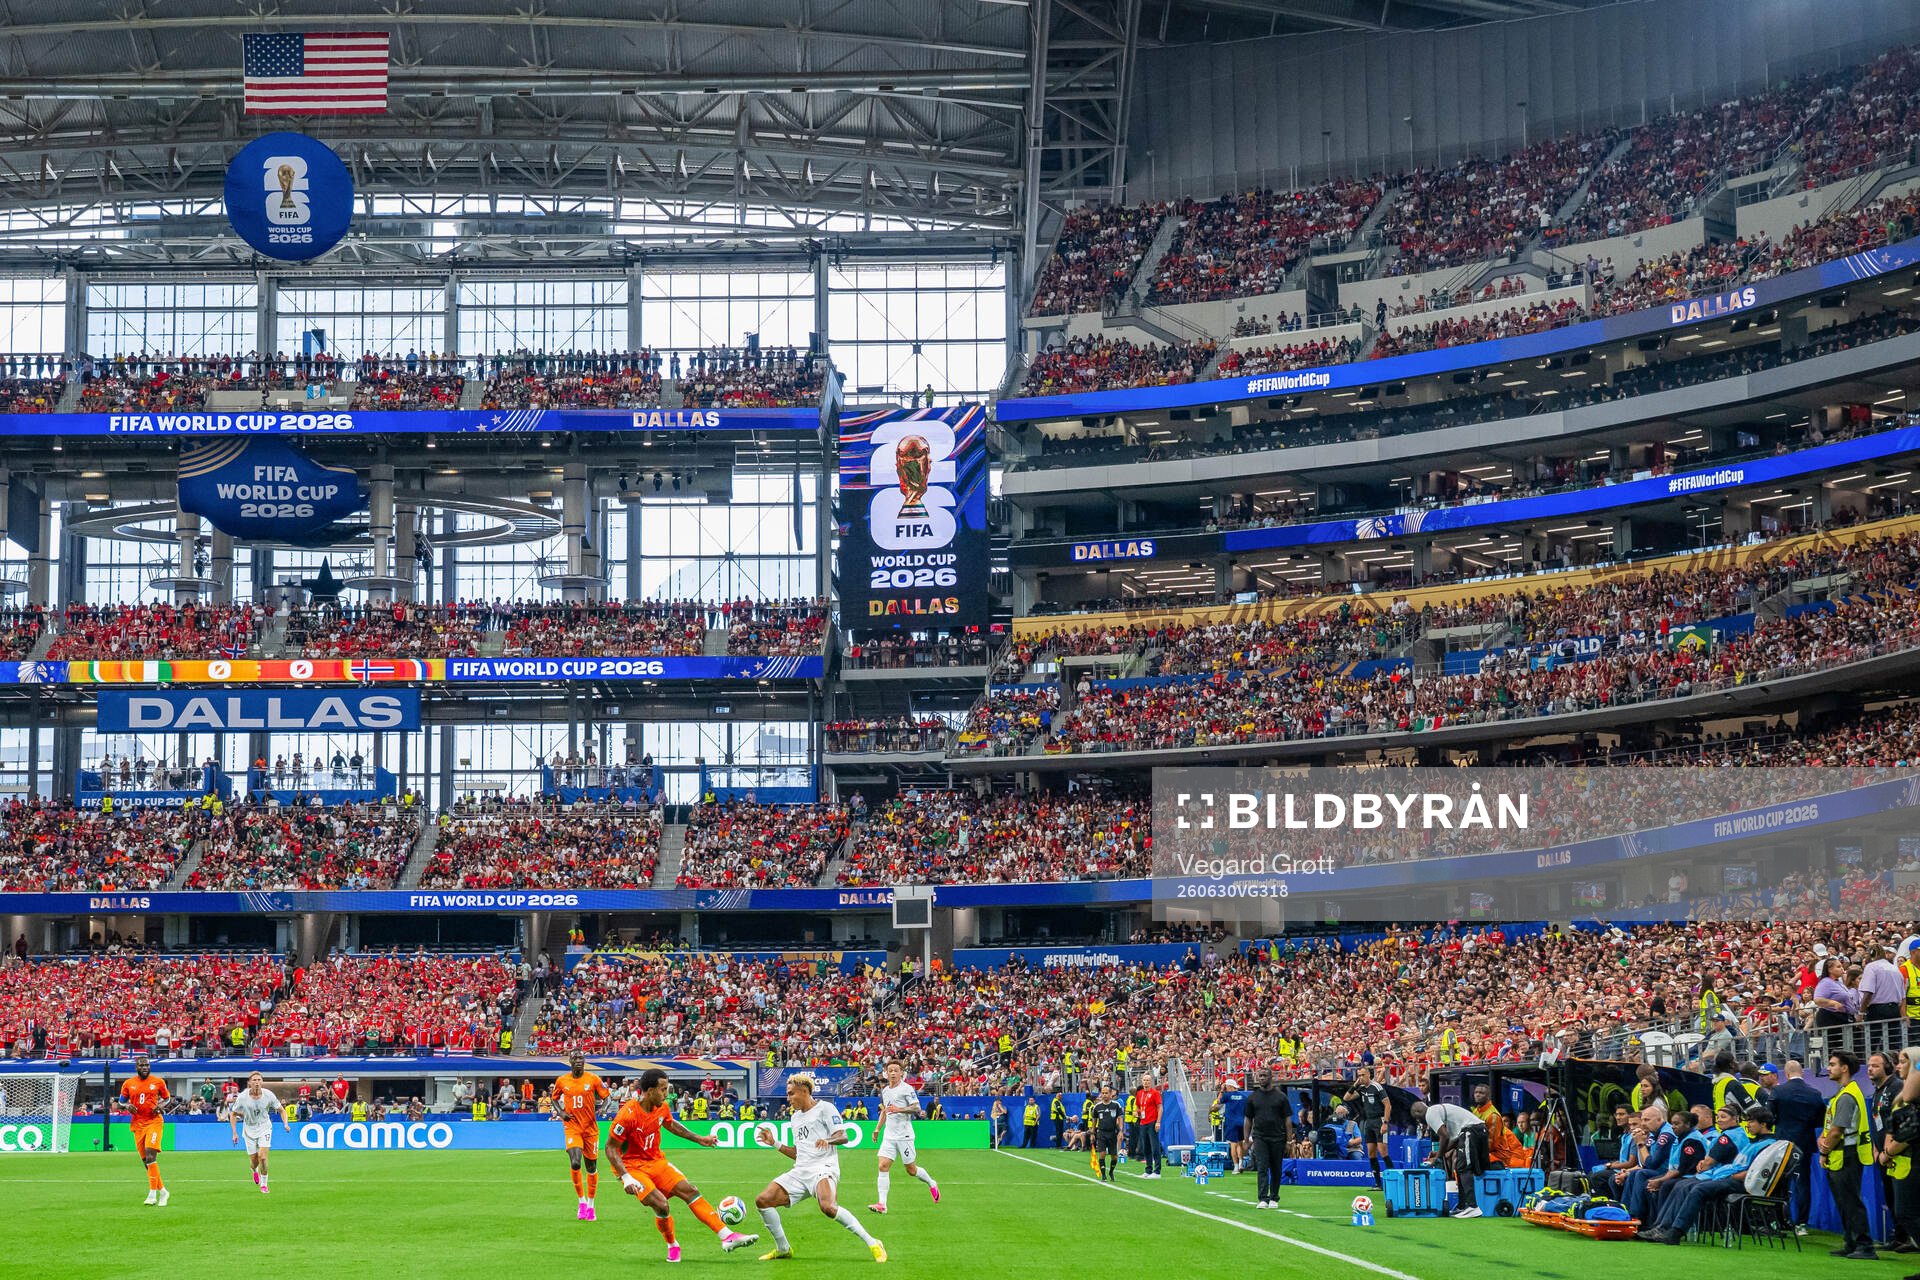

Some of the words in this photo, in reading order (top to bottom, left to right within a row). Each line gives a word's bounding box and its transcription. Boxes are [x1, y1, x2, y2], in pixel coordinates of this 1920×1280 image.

[279, 211, 299, 219] FIFA
[269, 234, 313, 243] 2026
[1672, 288, 1755, 324] DALLAS
[1247, 372, 1330, 394] #FIFAWorldCup
[110, 416, 153, 431] FIFA
[157, 415, 232, 431] WORLD
[235, 415, 277, 430] CUP
[280, 414, 353, 430] 2026
[633, 412, 720, 427] DALLAS
[254, 465, 299, 482] FIFA
[1668, 470, 1744, 493] #FIFAWorldCup
[216, 483, 293, 500] WORLD
[296, 485, 339, 500] CUP
[240, 504, 315, 518] 2026
[895, 524, 934, 538] FIFA
[1075, 541, 1153, 560] DALLAS
[871, 555, 925, 568] WORLD
[926, 554, 957, 566] CUP
[870, 568, 957, 589] 2026
[869, 597, 960, 616] DALLAS
[452, 662, 491, 676] FIFA
[494, 662, 559, 676] WORLD
[561, 662, 598, 675] CUP
[600, 661, 664, 675] 2026
[128, 697, 403, 728] DALLAS
[144, 799, 164, 807] CUP
[166, 798, 202, 806] 206
[1714, 822, 1733, 838] FIFA
[1733, 816, 1765, 834] WORLD
[1766, 809, 1784, 828] CUP
[1785, 804, 1819, 825] 2026
[1537, 851, 1571, 868] DALLAS
[90, 897, 150, 909] DALLAS
[410, 896, 441, 907] FIFA
[443, 895, 495, 907] WORLD
[497, 895, 526, 906] CUP
[528, 895, 578, 906] 2026
[139, 1093, 145, 1105] 8
[572, 1095, 583, 1109] 19
[151, 1132, 157, 1145] 8
[299, 1122, 453, 1149] aramco
[643, 1133, 655, 1151] 17
